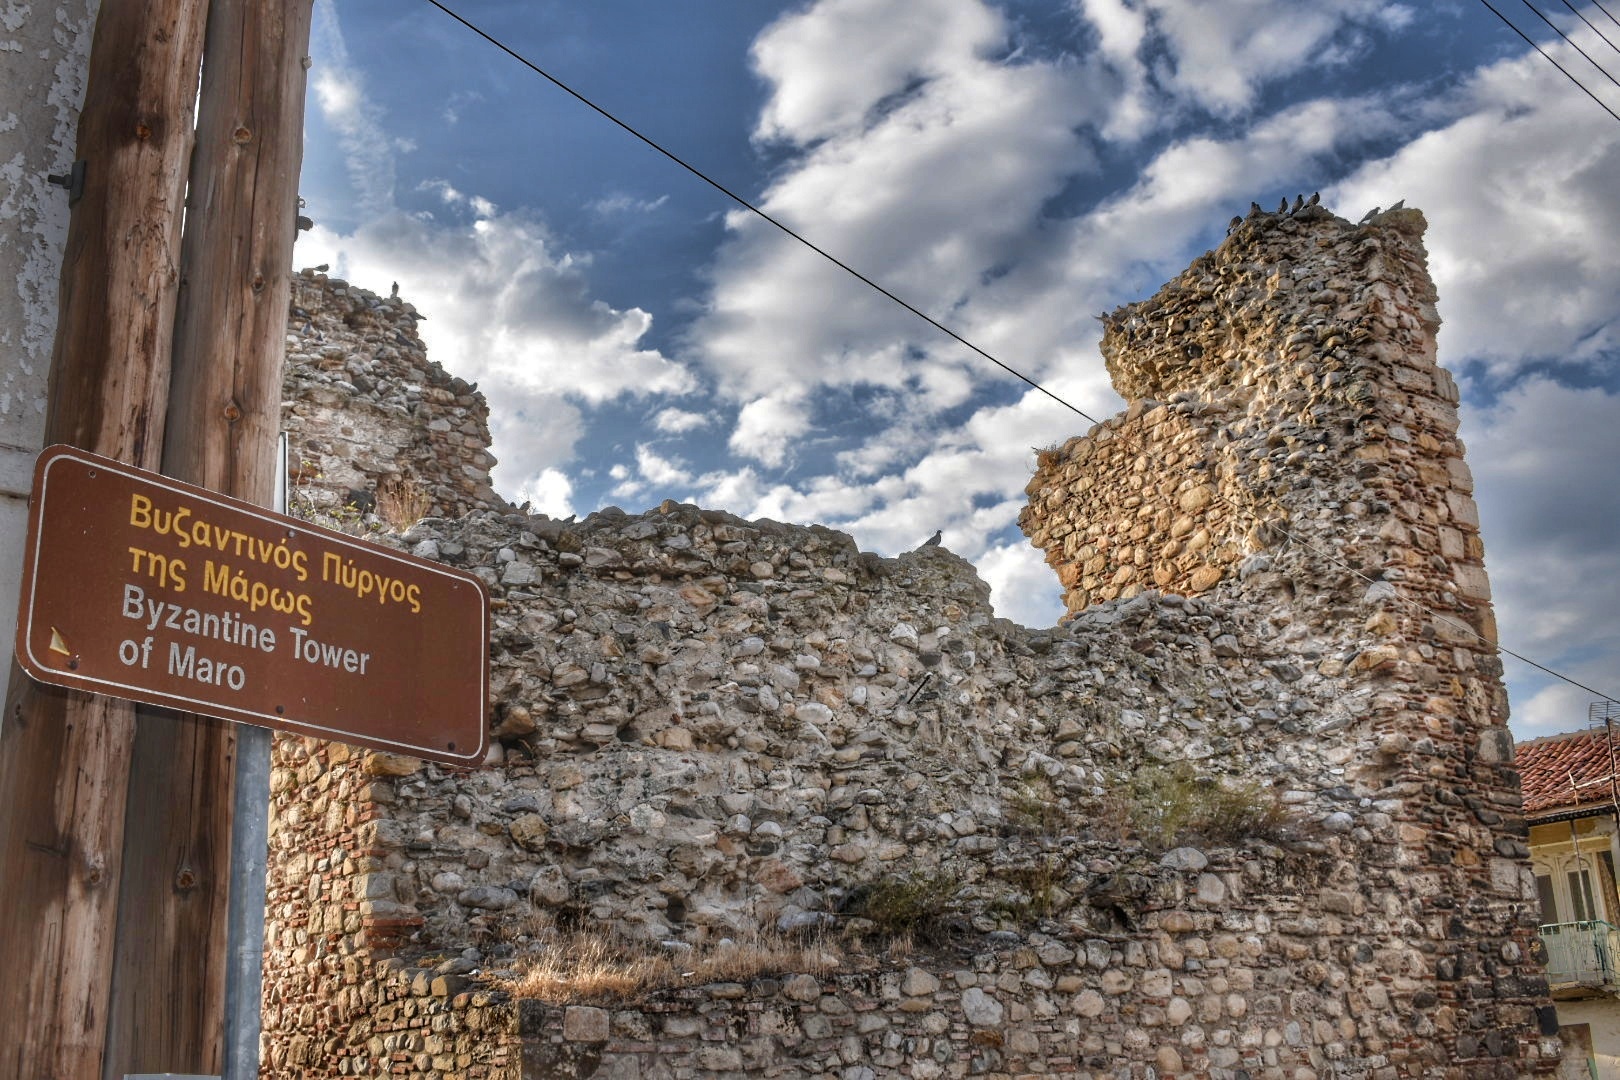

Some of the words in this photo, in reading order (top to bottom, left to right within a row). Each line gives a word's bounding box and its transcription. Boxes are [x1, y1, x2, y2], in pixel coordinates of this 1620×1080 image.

[128, 546, 187, 592] της
[203, 560, 313, 626] Μάρως
[130, 493, 308, 582] Βυζαντινός
[322, 551, 421, 613] Πύργος
[119, 636, 153, 669] of
[168, 642, 246, 691] Maro
[122, 583, 276, 653] Byzantine
[289, 626, 370, 675] Tower
